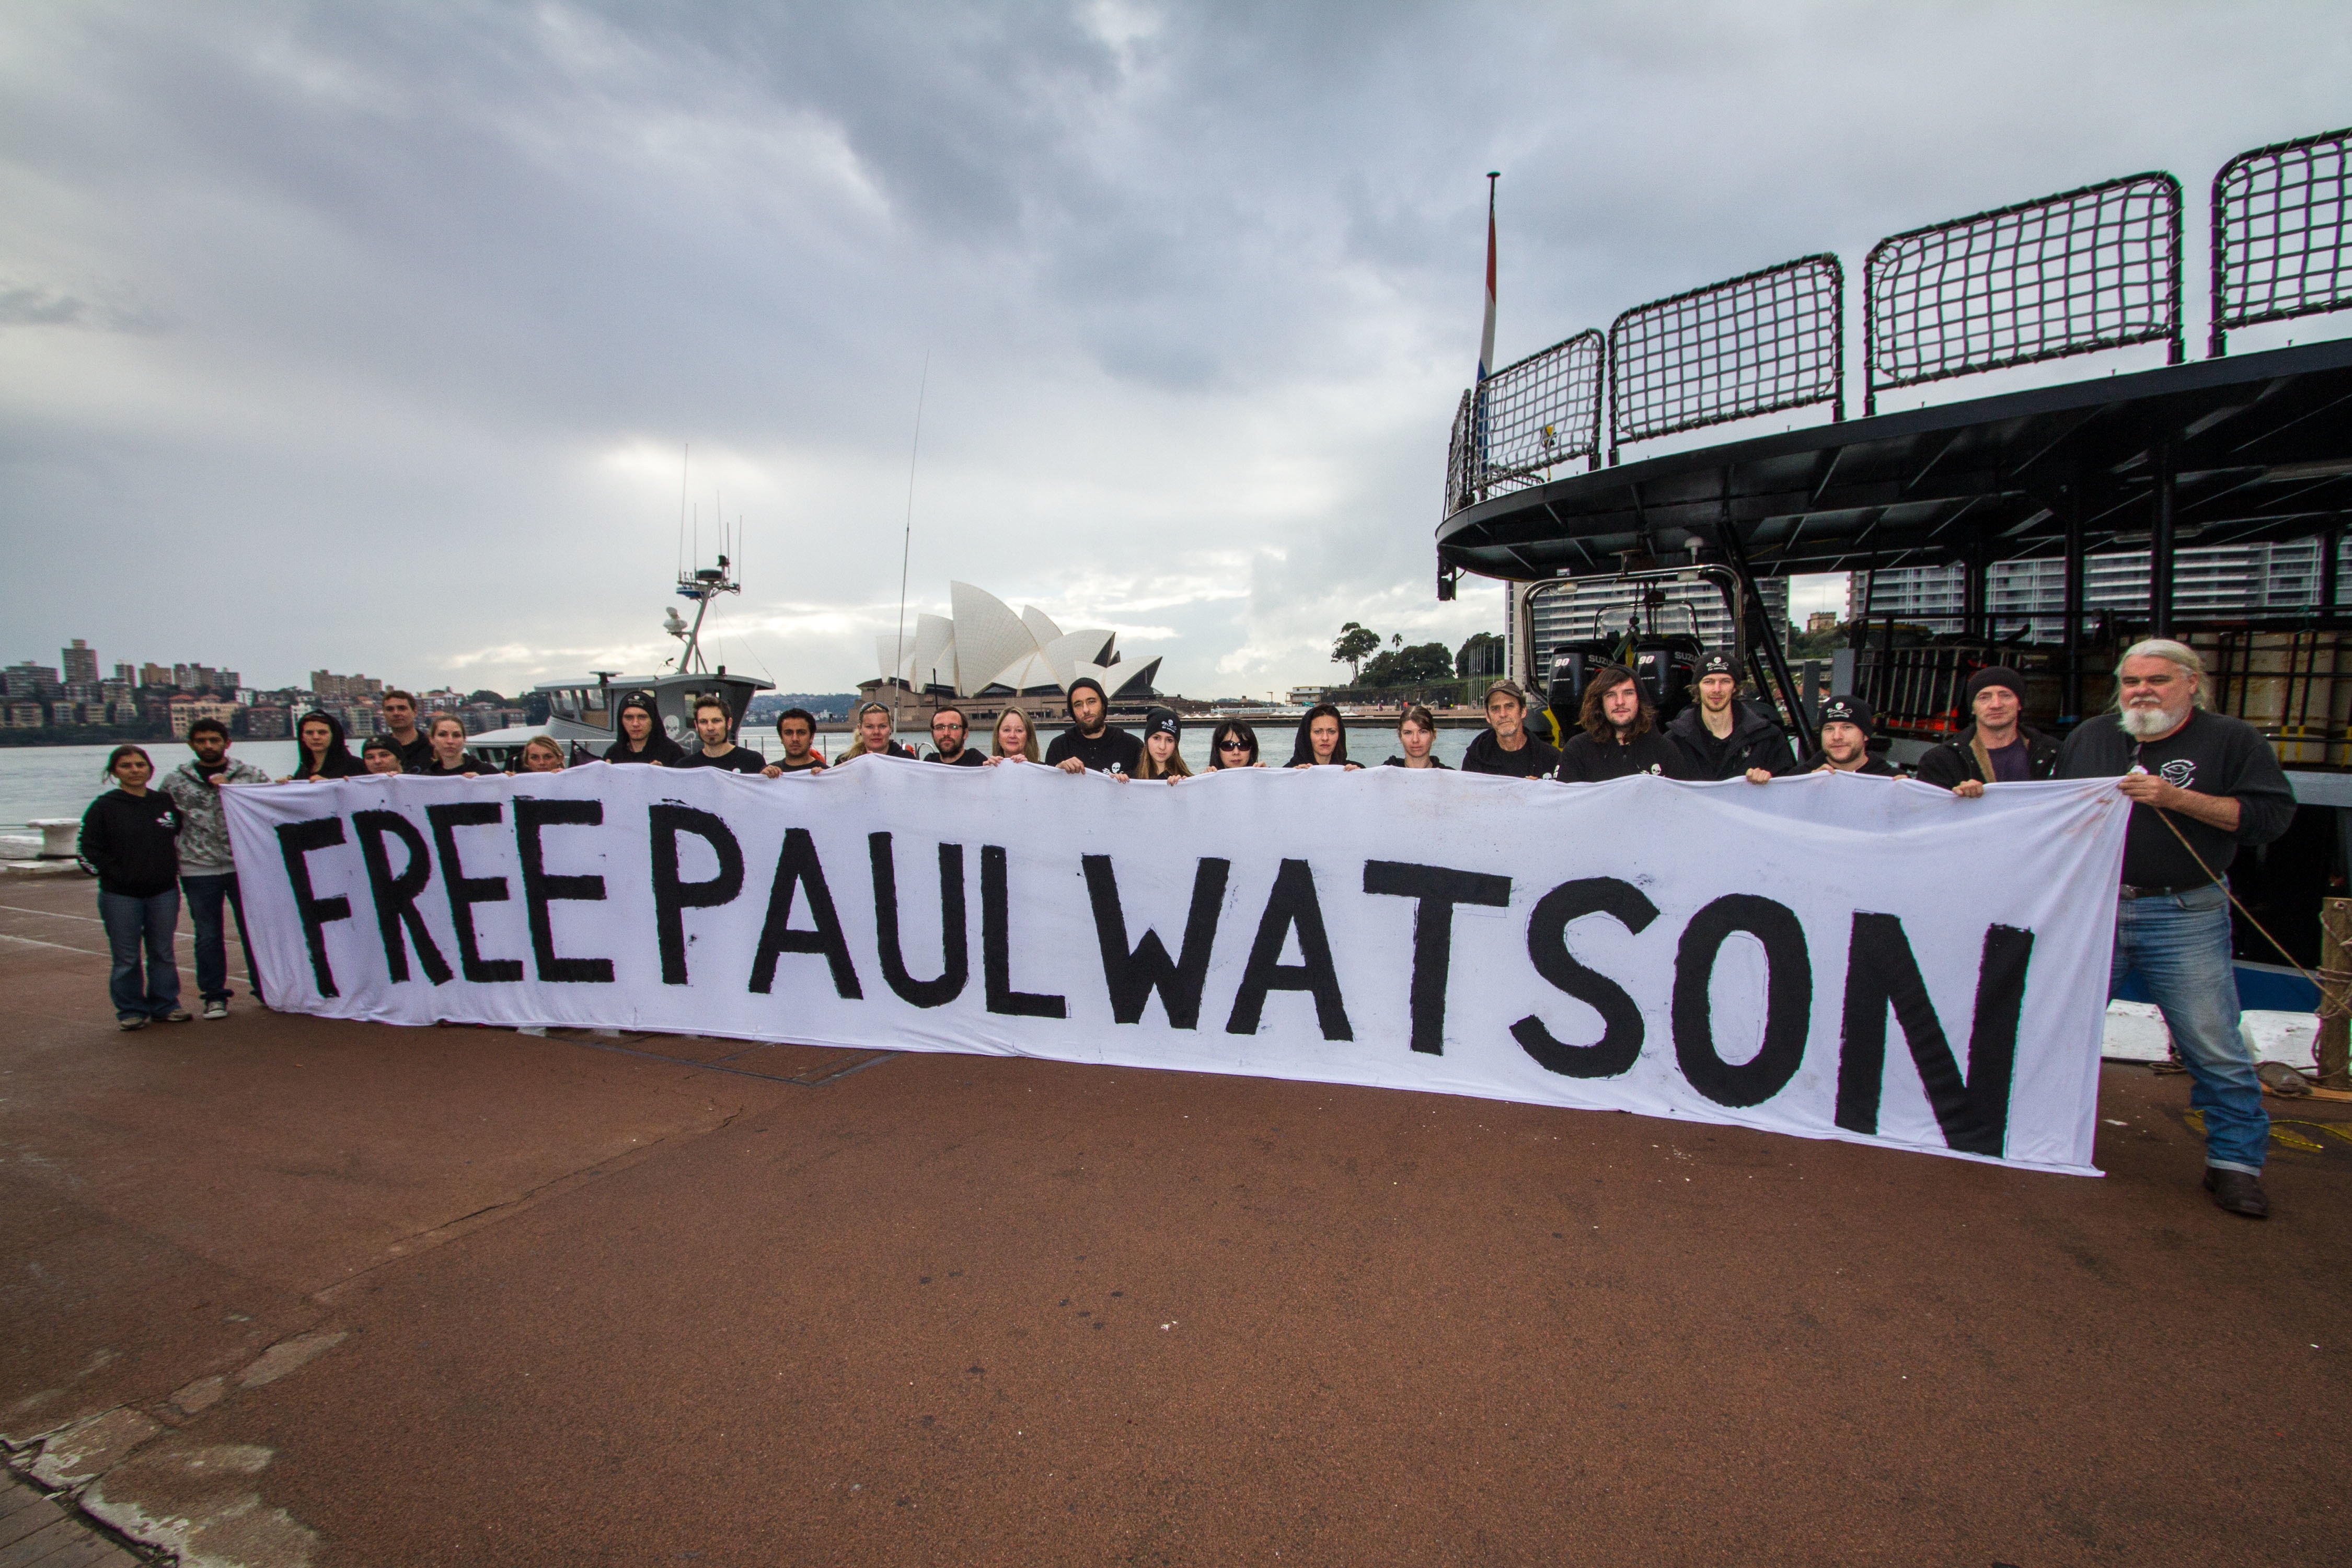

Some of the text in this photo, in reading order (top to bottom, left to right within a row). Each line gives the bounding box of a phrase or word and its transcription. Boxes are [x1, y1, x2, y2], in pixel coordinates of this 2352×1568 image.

[1554, 658, 1570, 667] 90
[1638, 655, 1655, 665] 90
[274, 795, 2035, 1159] FREE PAUL WATSON
